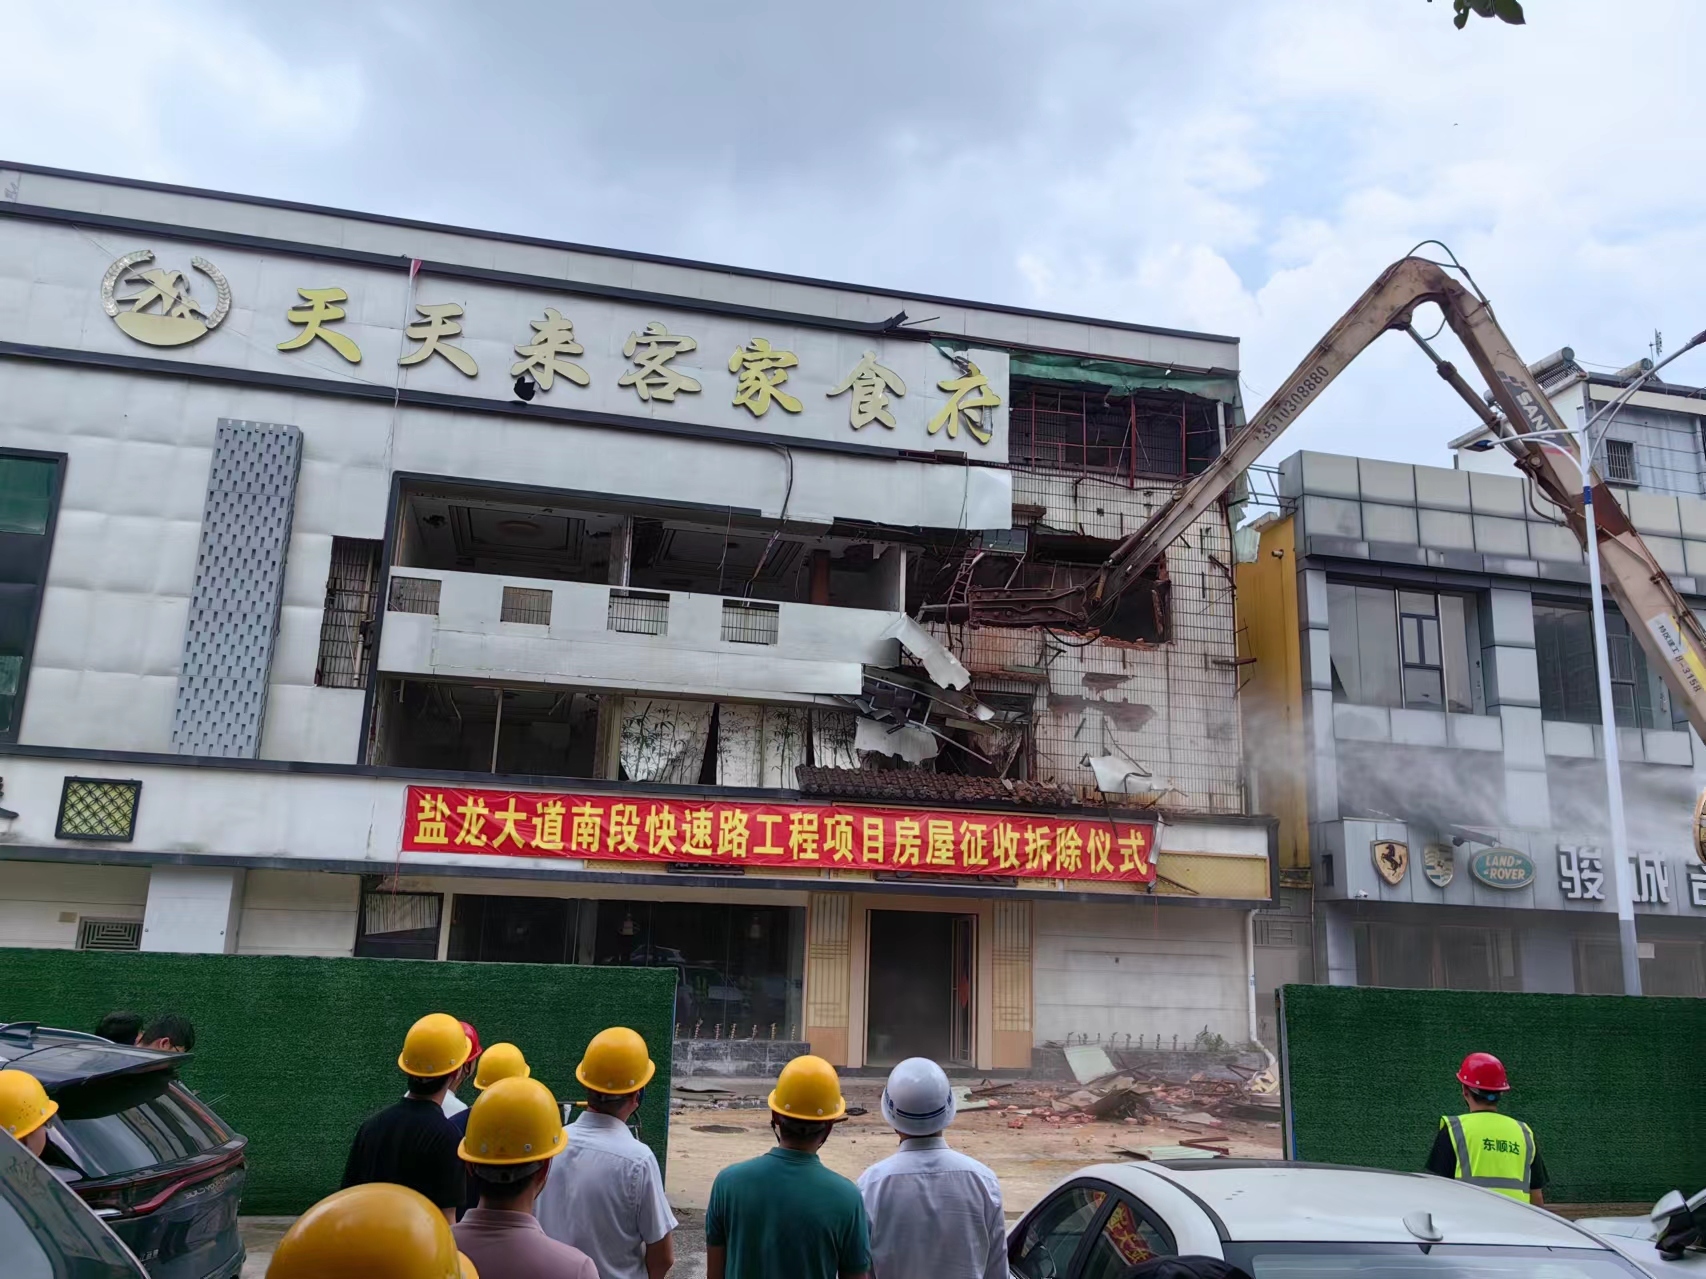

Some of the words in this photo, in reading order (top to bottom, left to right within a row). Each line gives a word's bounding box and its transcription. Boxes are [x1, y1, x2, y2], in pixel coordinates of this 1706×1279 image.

[277, 286, 1001, 444] 天天来客家食府
[413, 793, 1148, 875] 盐龙大道南段快速路工程项目房屋征收拆除仪式
[1485, 855, 1515, 867] LAND
[1490, 867, 1526, 880] ROVER
[1482, 1138, 1520, 1156] 东顺达
